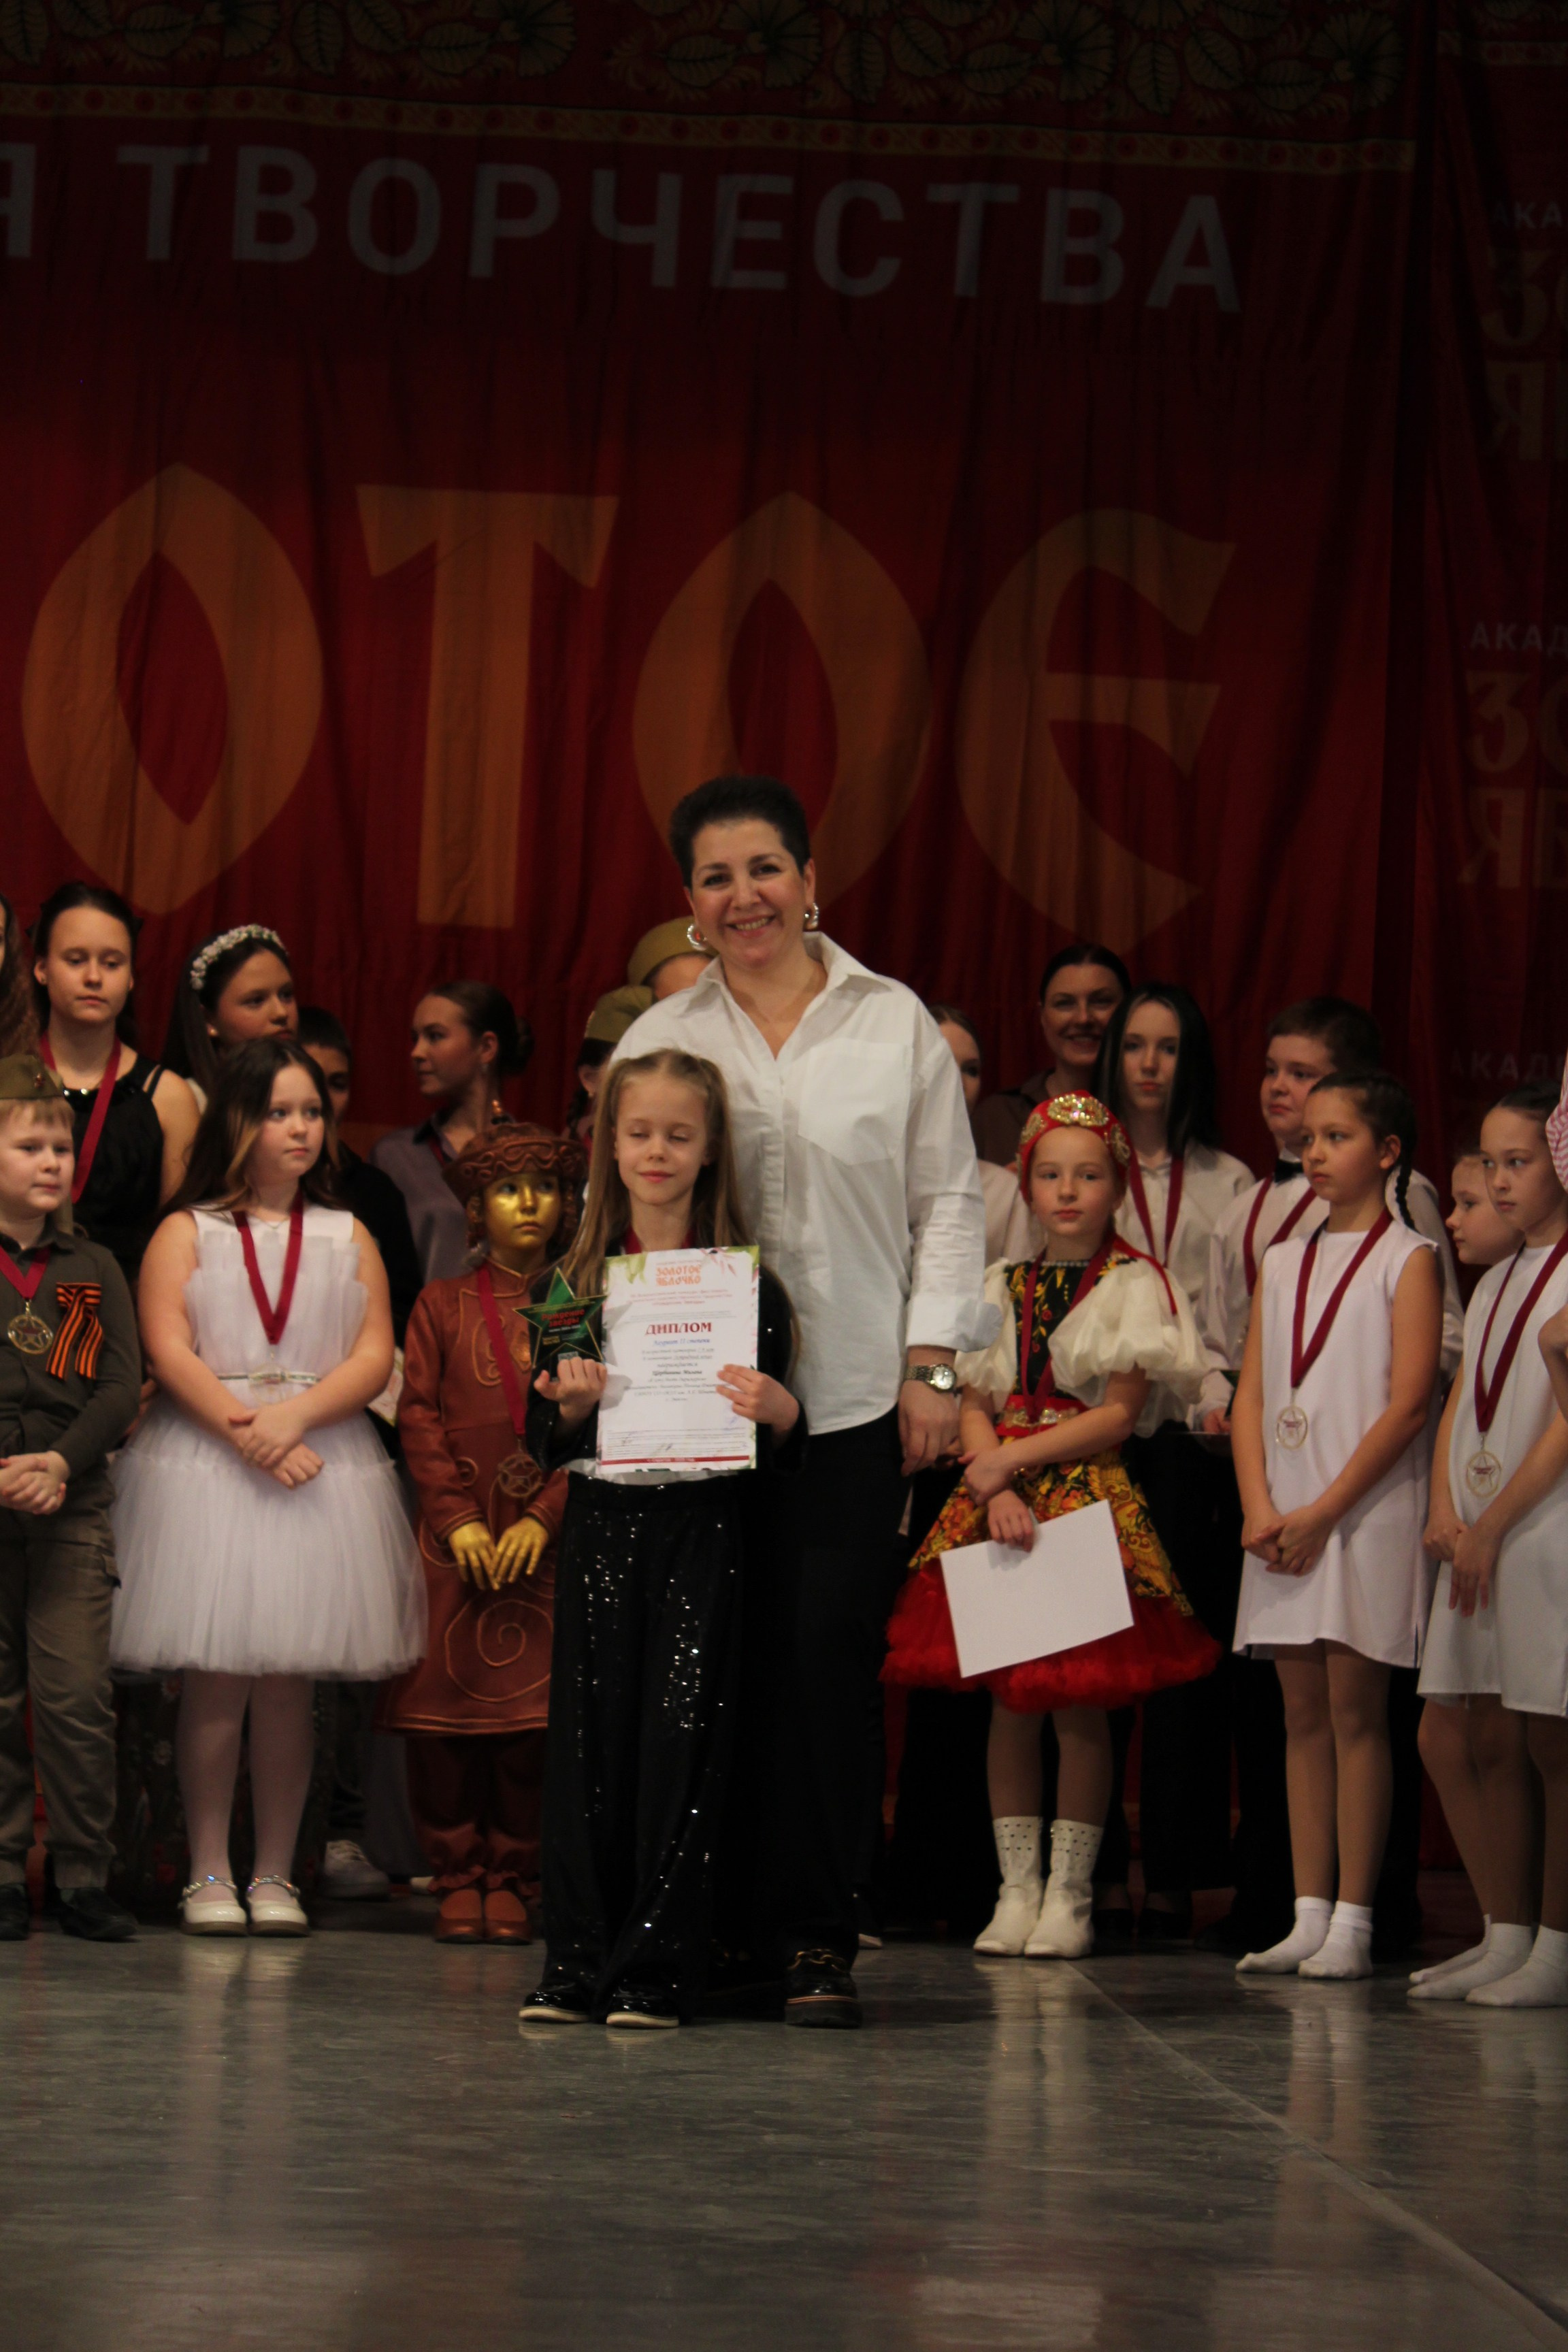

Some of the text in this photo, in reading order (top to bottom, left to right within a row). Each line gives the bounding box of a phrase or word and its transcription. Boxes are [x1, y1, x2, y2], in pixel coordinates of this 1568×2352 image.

[116, 143, 1243, 314] ТВОРЧЕСТВА
[1480, 245, 1568, 346] З
[1482, 361, 1568, 461] Я
[645, 1322, 712, 1335] ДИПЛОМ
